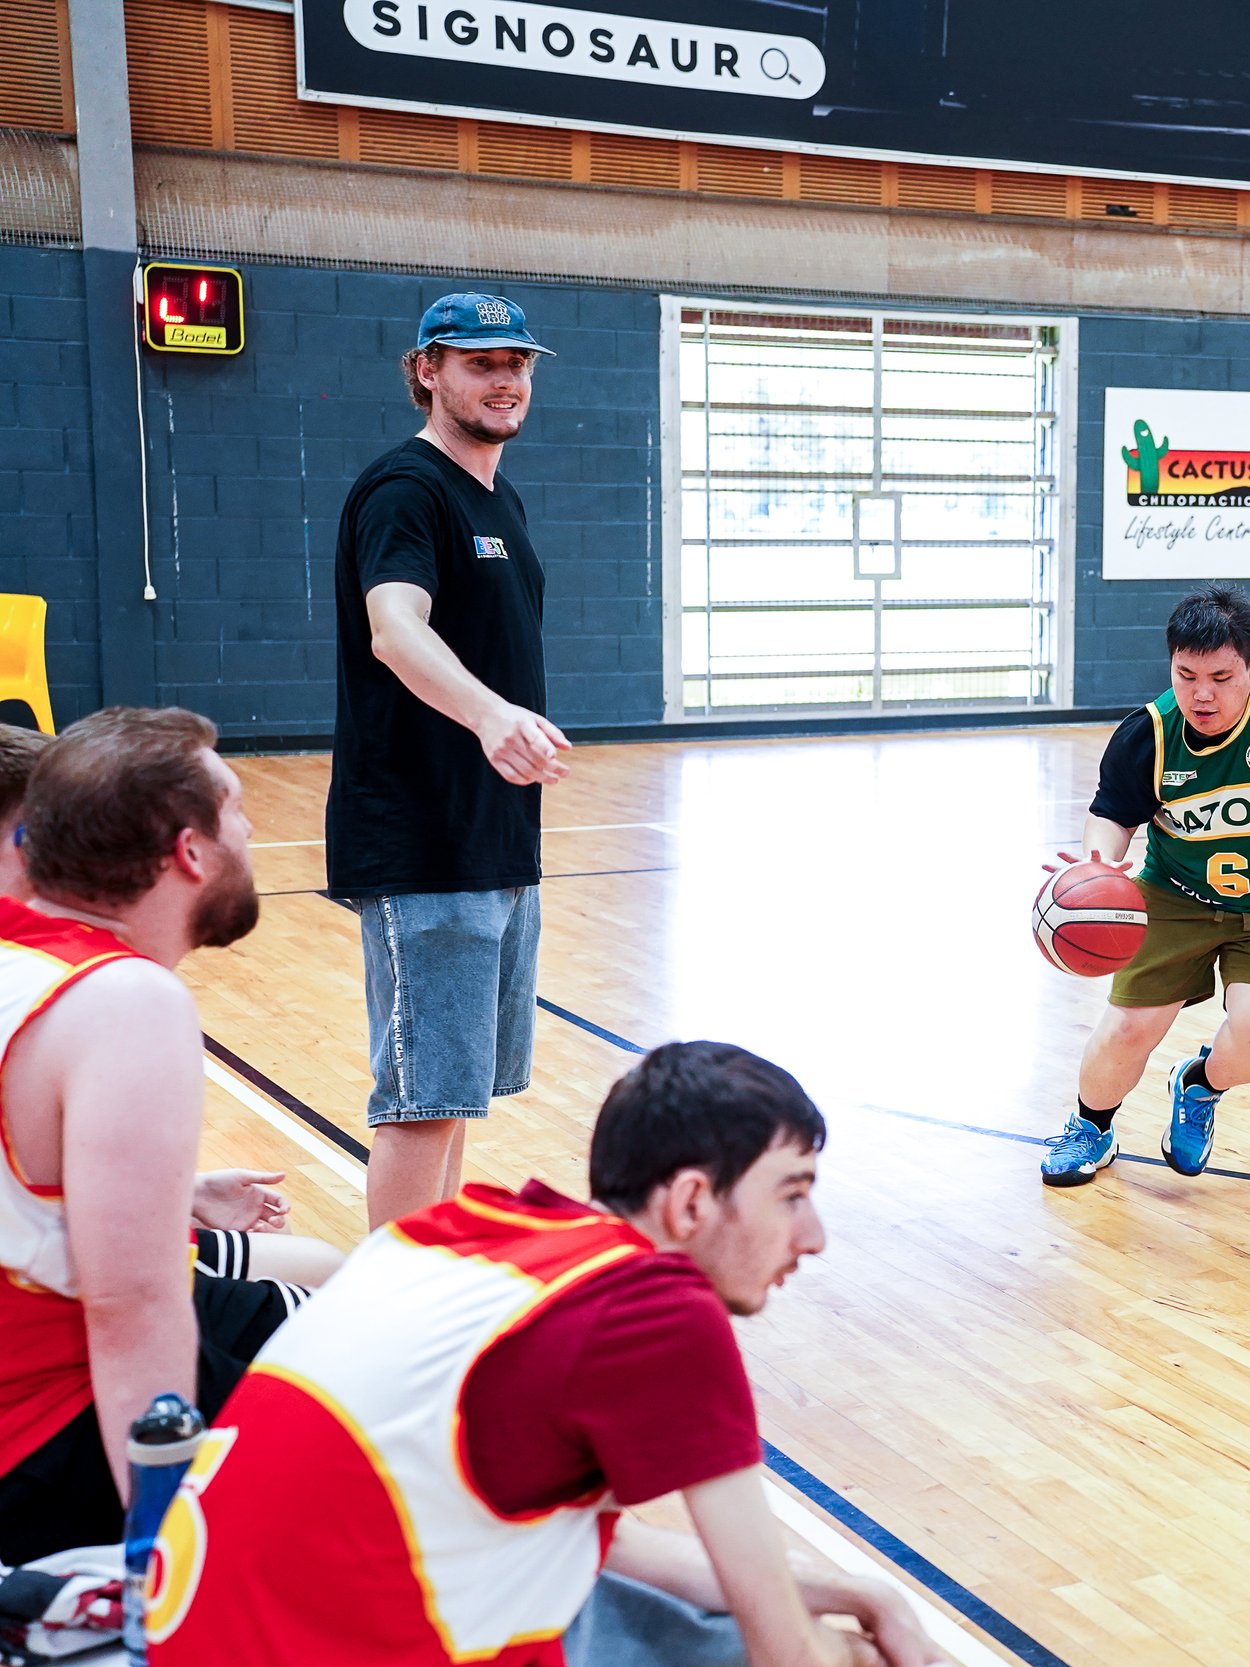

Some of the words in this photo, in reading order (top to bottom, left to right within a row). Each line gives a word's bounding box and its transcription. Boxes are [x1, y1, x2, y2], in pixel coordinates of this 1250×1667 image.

[372, 0, 740, 78] SIGNOSAUR
[170, 328, 223, 344] Bodet
[1124, 515, 1196, 550] Lifestyle
[1207, 852, 1250, 898] 6
